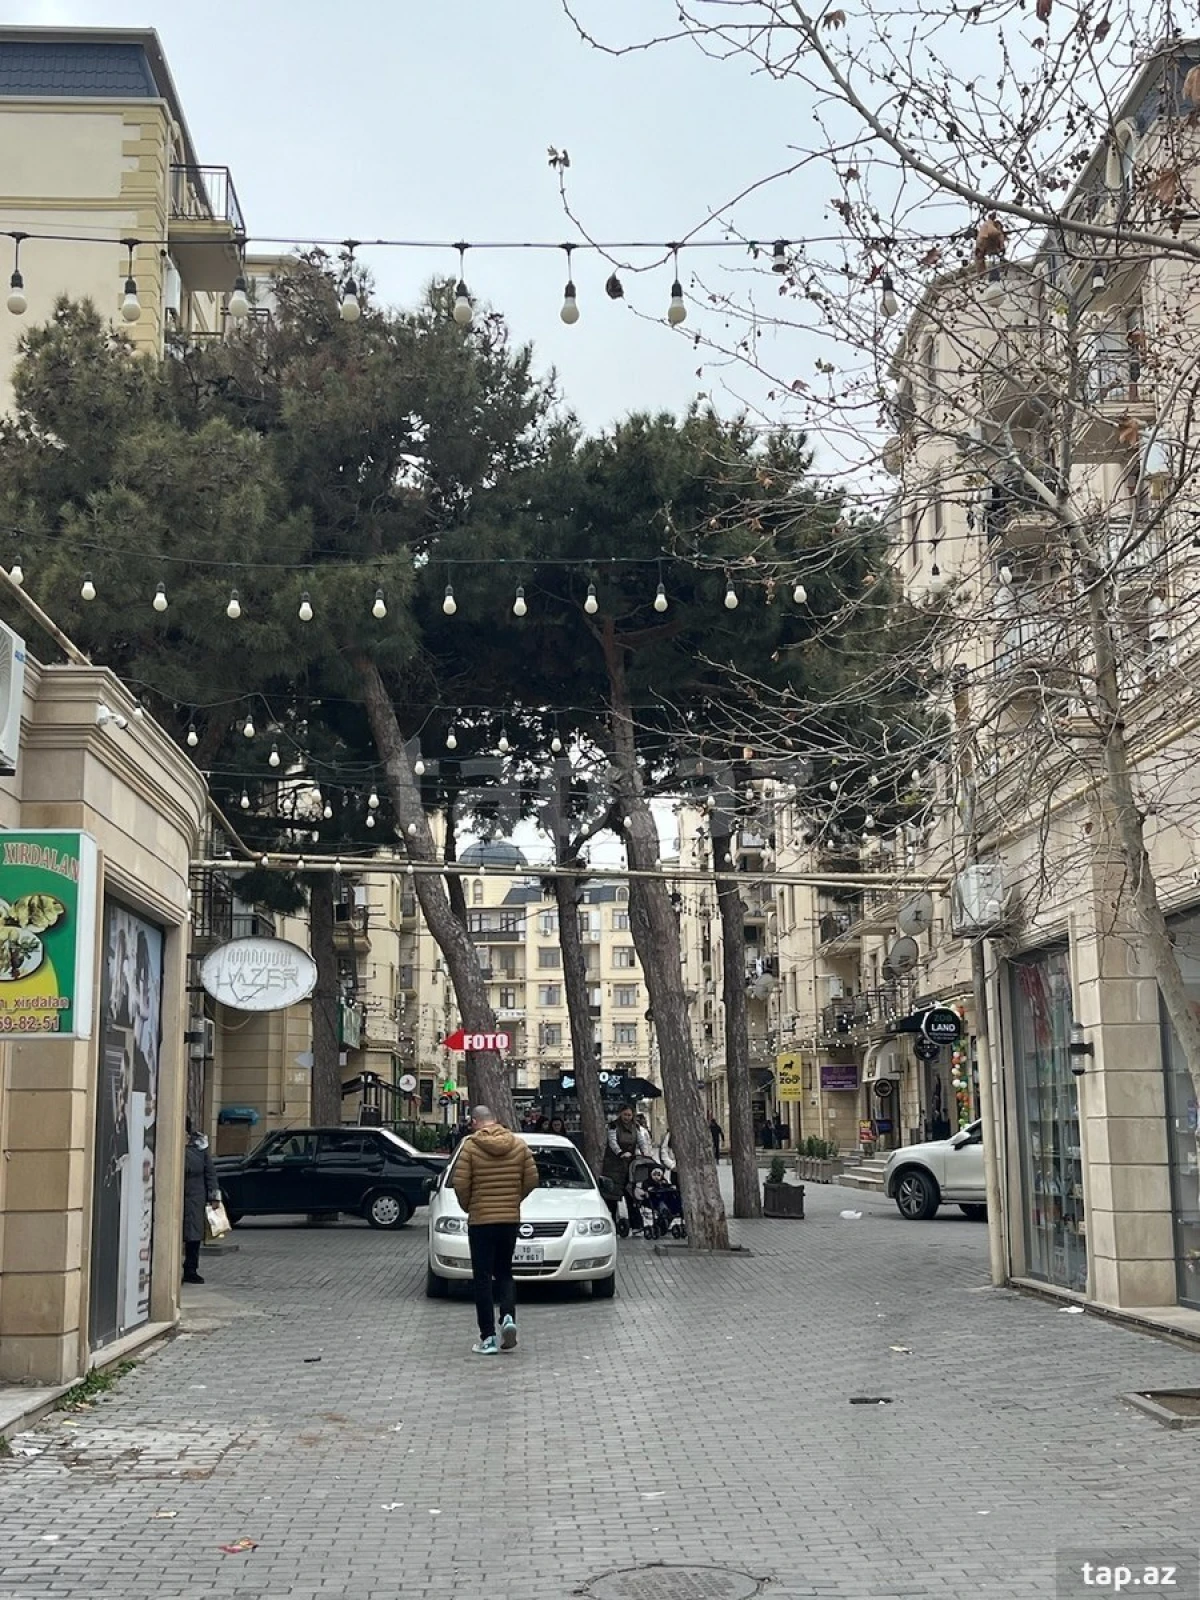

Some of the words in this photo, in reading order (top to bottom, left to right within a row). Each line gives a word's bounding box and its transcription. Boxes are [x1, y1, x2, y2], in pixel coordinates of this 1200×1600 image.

[3, 842, 80, 883] XIRDALAN
[931, 1023, 956, 1033] LAND
[463, 1033, 509, 1050] FOTO
